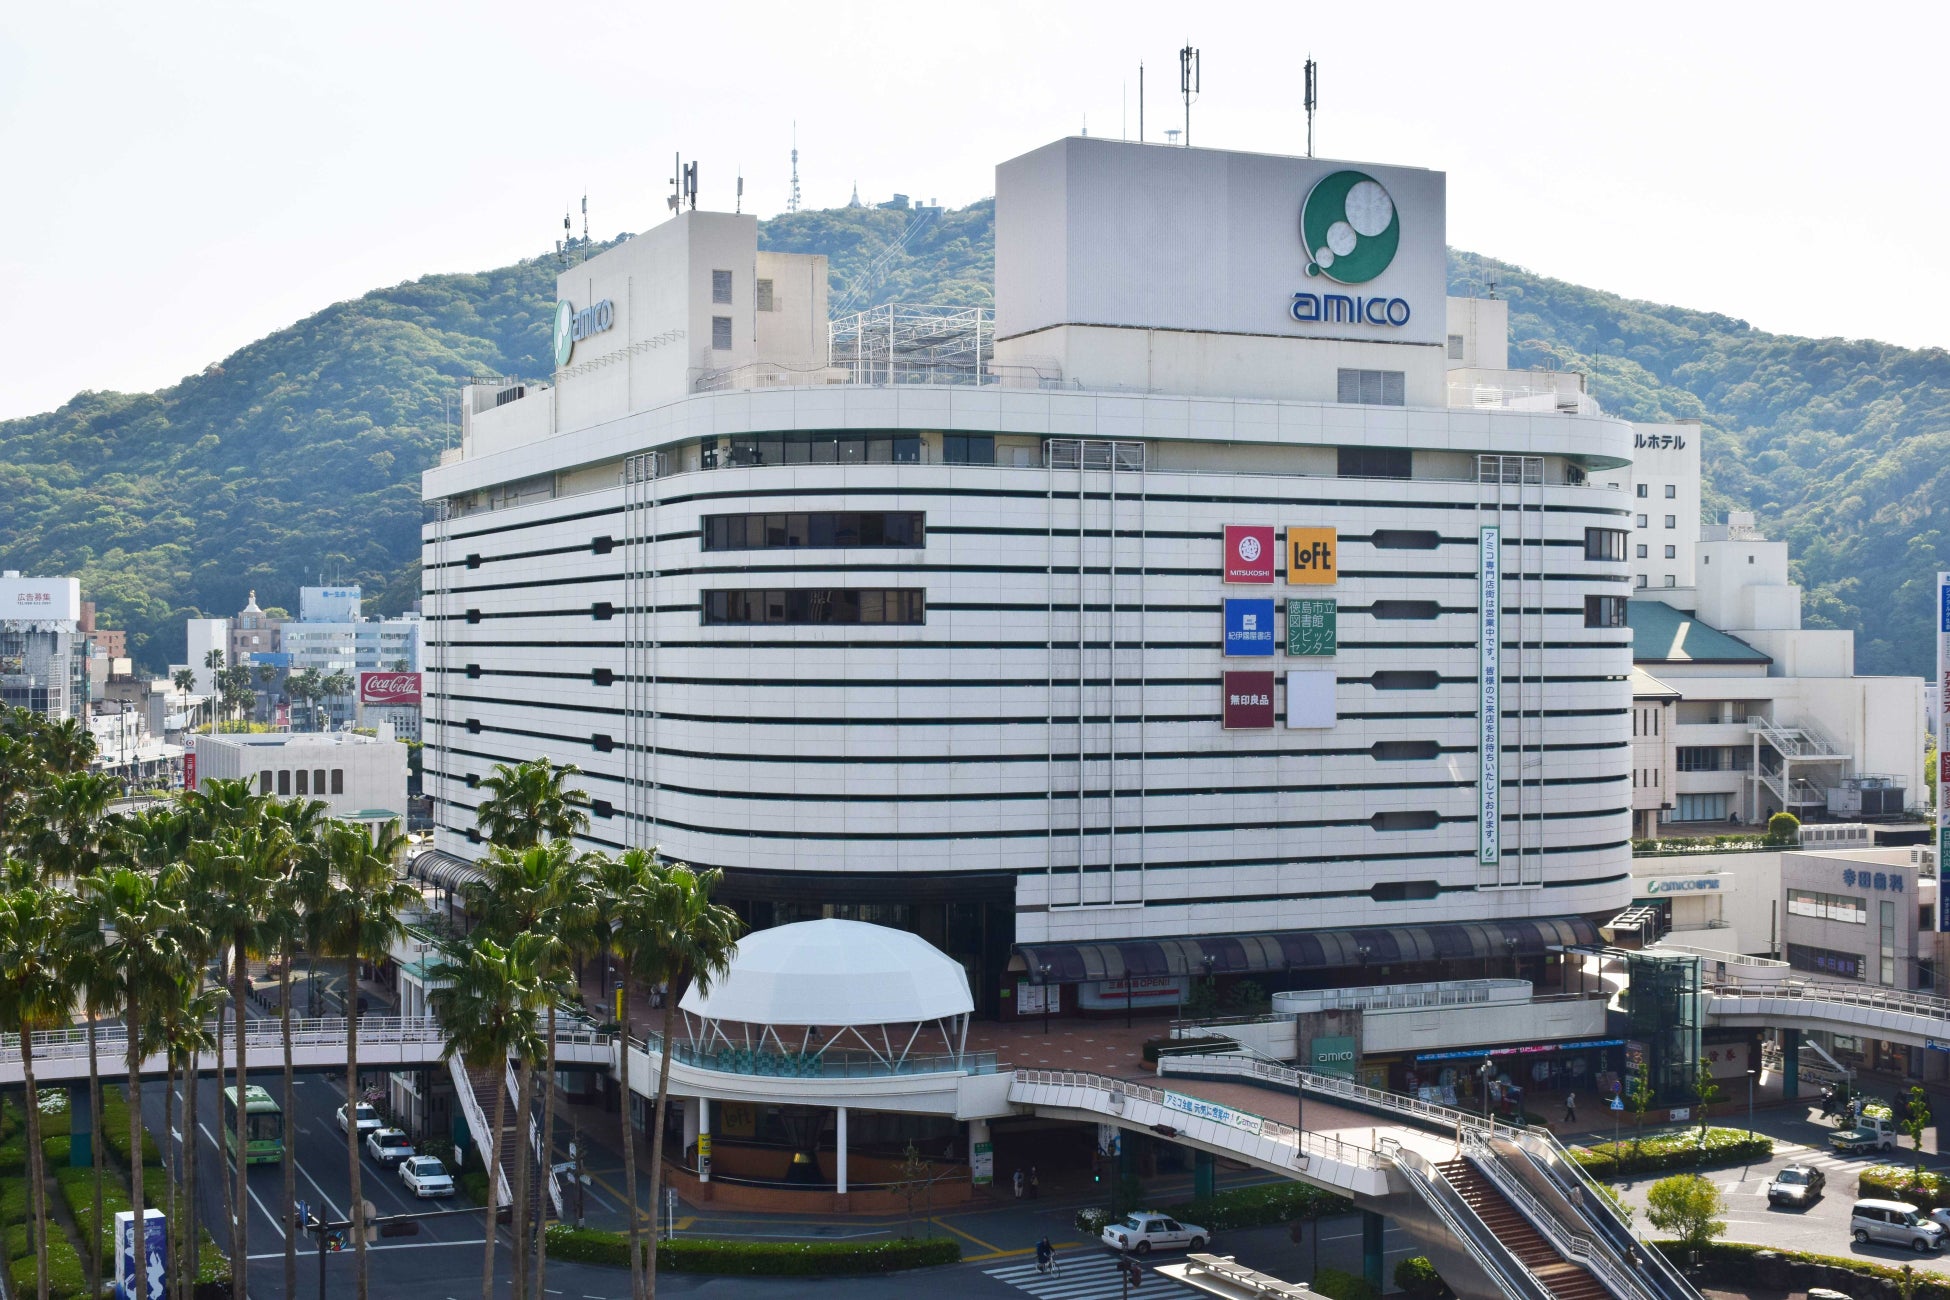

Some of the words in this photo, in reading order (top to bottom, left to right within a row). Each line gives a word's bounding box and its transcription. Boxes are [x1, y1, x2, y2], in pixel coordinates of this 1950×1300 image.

[1290, 292, 1410, 327] amico
[572, 300, 614, 342] amico
[1634, 433, 1686, 450] ルホテル
[1230, 569, 1270, 577] MITSUKOSHI
[17, 592, 51, 601] 広告募集
[1289, 601, 1335, 614] 徳島市立
[1289, 614, 1324, 628] 図書館
[1289, 629, 1334, 642] シビック
[1289, 642, 1335, 655] センター
[1230, 694, 1270, 706] 無印良品
[1318, 1051, 1353, 1062] amico
